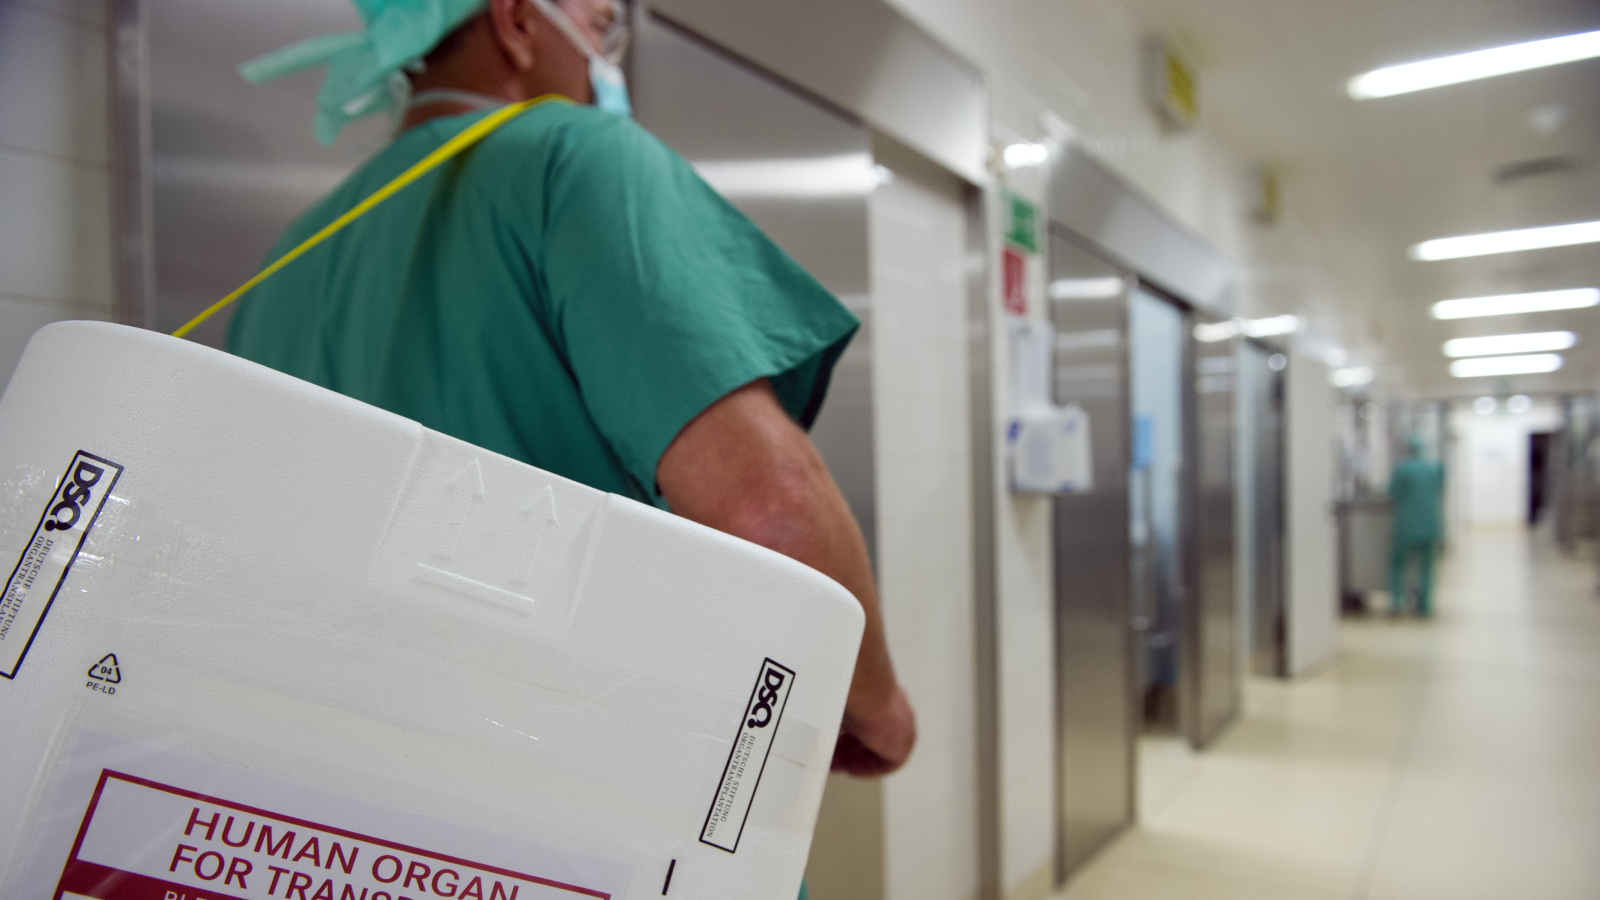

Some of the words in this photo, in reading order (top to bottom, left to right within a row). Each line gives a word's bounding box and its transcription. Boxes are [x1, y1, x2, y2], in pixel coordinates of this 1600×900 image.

[22, 538, 54, 590] DEUTSCHE
[86, 681, 116, 695] PE-LD
[100, 666, 112, 676] 04
[735, 735, 756, 779] DEUTSCHE
[706, 732, 748, 838] ORGANTRANSPLANTATION
[720, 780, 739, 823] STIFTUNG
[168, 843, 253, 890] FOR
[184, 807, 360, 875] HUMAN
[371, 854, 519, 900] ORGAN
